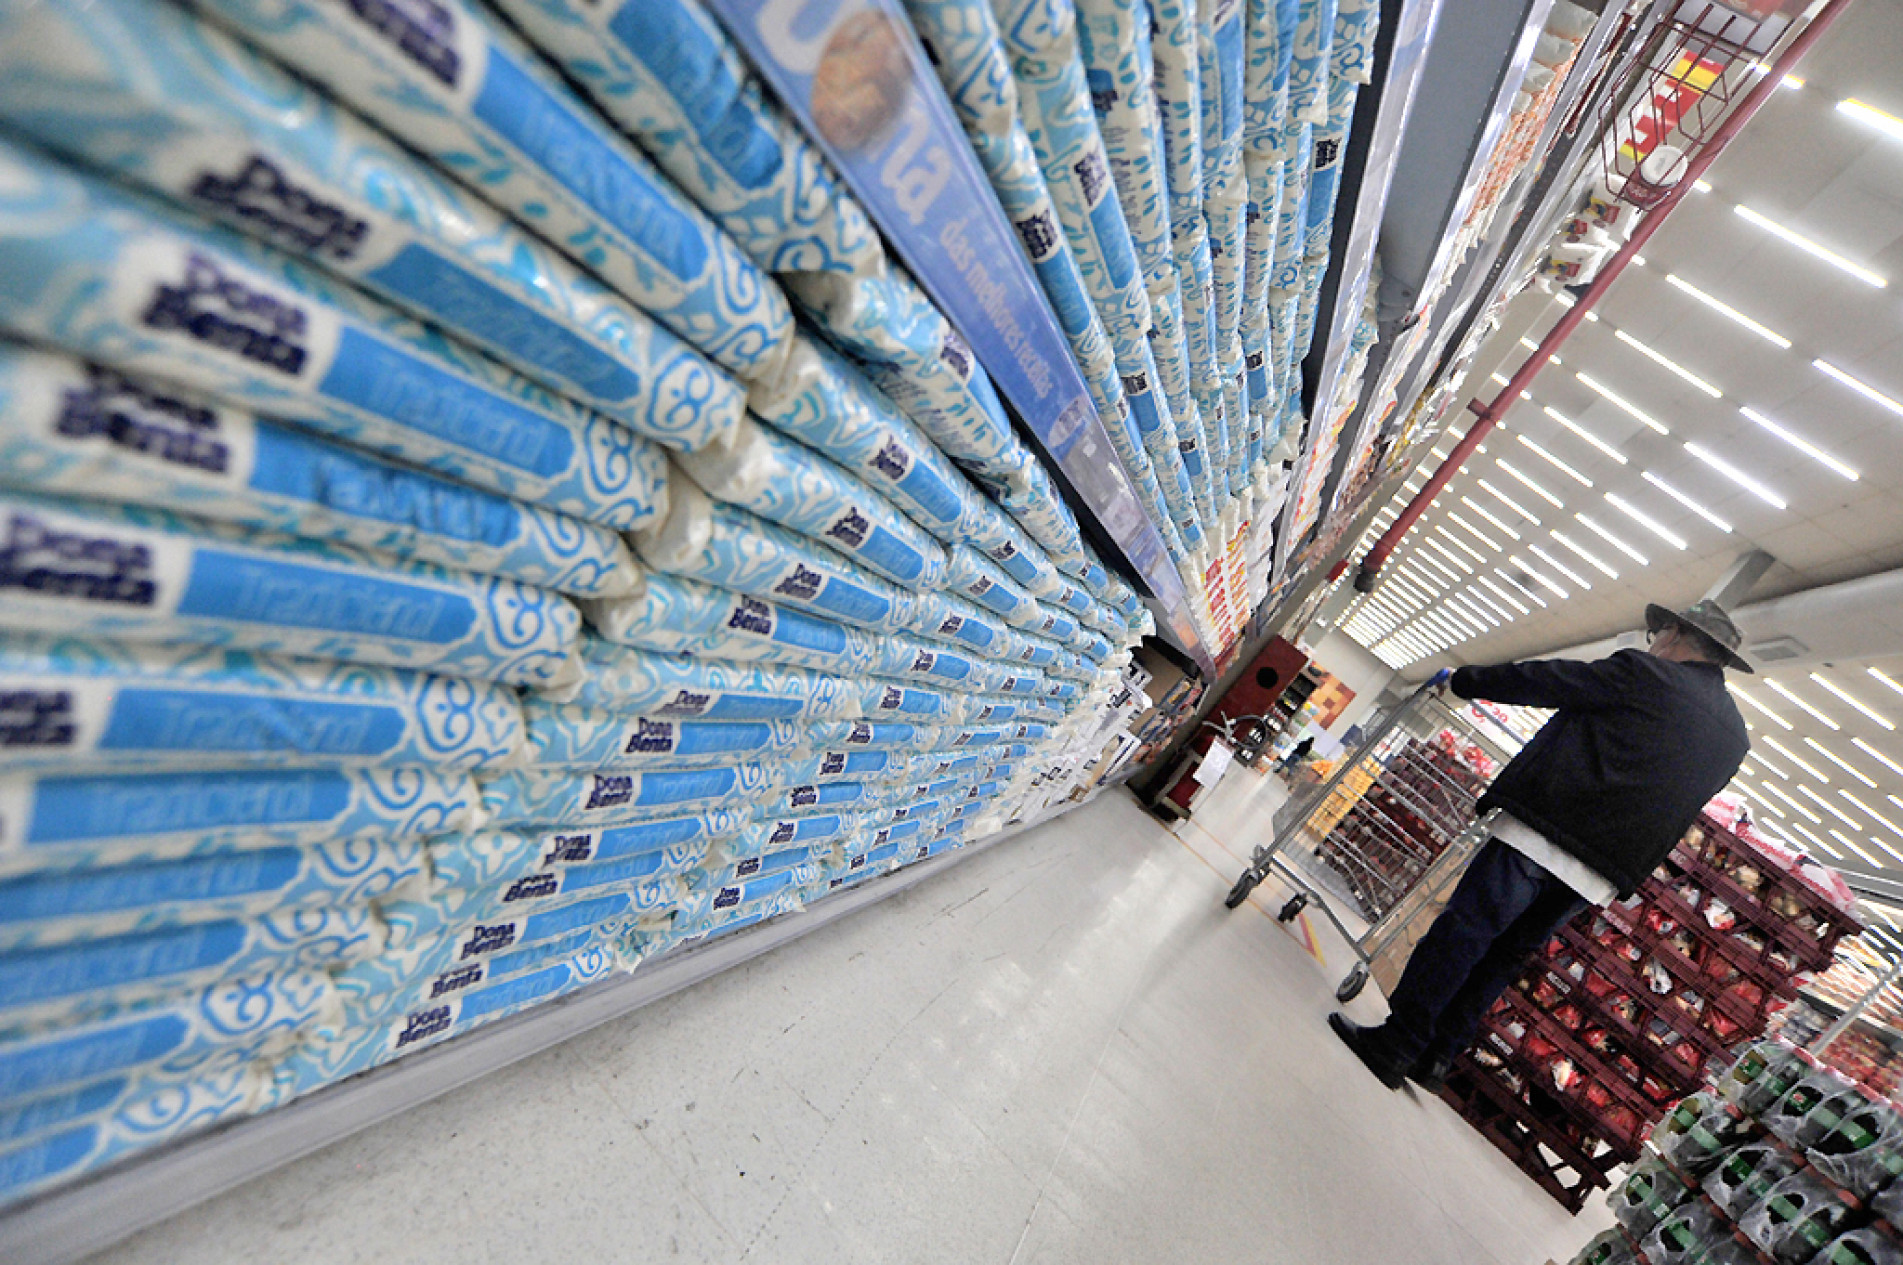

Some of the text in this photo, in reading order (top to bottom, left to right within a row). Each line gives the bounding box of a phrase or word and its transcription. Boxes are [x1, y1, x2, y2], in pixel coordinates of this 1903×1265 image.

[638, 716, 673, 737] Dona
[624, 734, 673, 754] Benta
[594, 773, 633, 792] Dona
[474, 922, 515, 939] Dona
[460, 935, 516, 961] Benta
[407, 1004, 450, 1031] Dona
[395, 1017, 452, 1049] Benta
